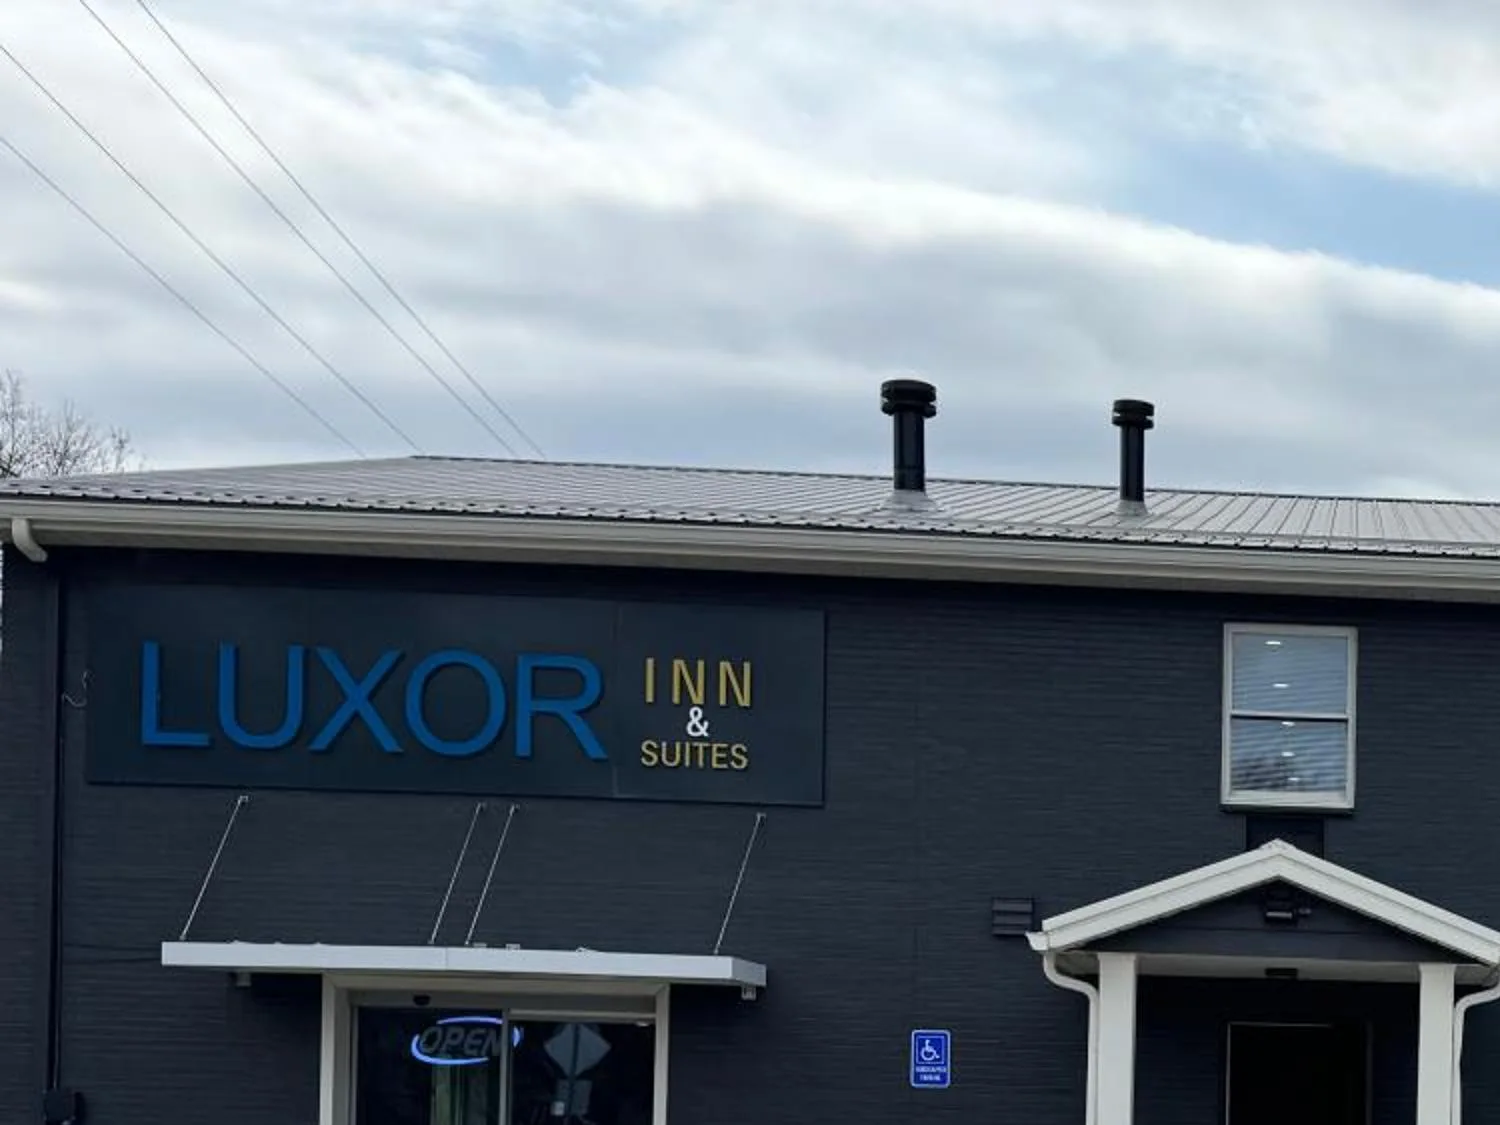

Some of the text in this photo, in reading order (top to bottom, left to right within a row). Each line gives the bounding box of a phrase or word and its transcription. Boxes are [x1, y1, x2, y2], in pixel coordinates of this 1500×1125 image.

[645, 657, 751, 707] INN
[140, 640, 608, 760] LUXOR
[686, 706, 709, 737] &
[640, 739, 749, 769] SUITES
[420, 1026, 502, 1057] OPEN
